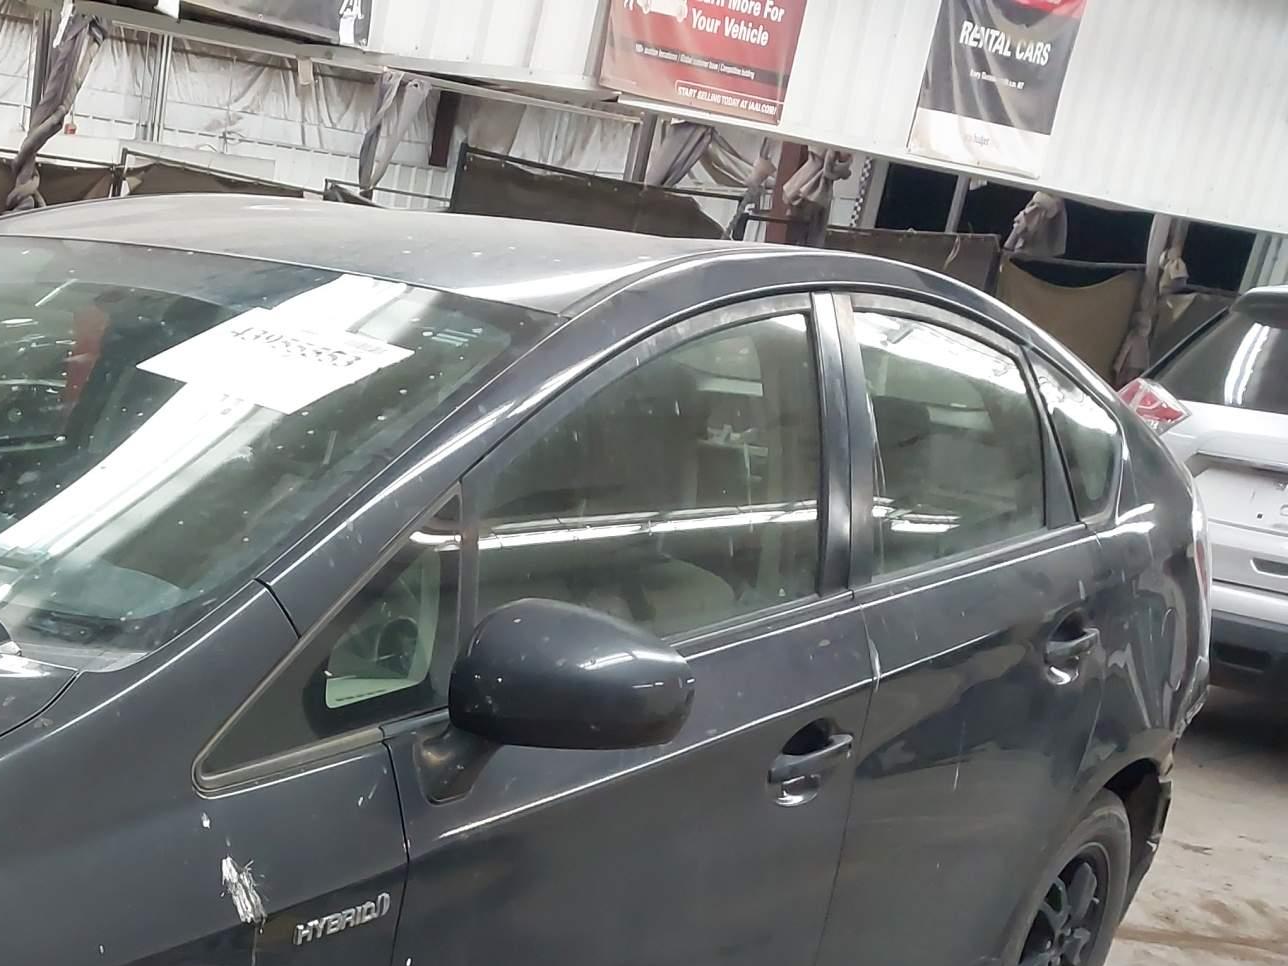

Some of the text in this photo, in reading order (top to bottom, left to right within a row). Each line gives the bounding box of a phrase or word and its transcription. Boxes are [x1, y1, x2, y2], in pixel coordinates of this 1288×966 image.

[692, 8, 769, 46] Your Vehicle
[763, 0, 785, 22] For
[959, 20, 1051, 66] RENTAL CARS
[678, 86, 697, 98] START
[721, 95, 741, 107] TODAY
[740, 99, 749, 108] AT
[292, 900, 379, 945] HYBRID
